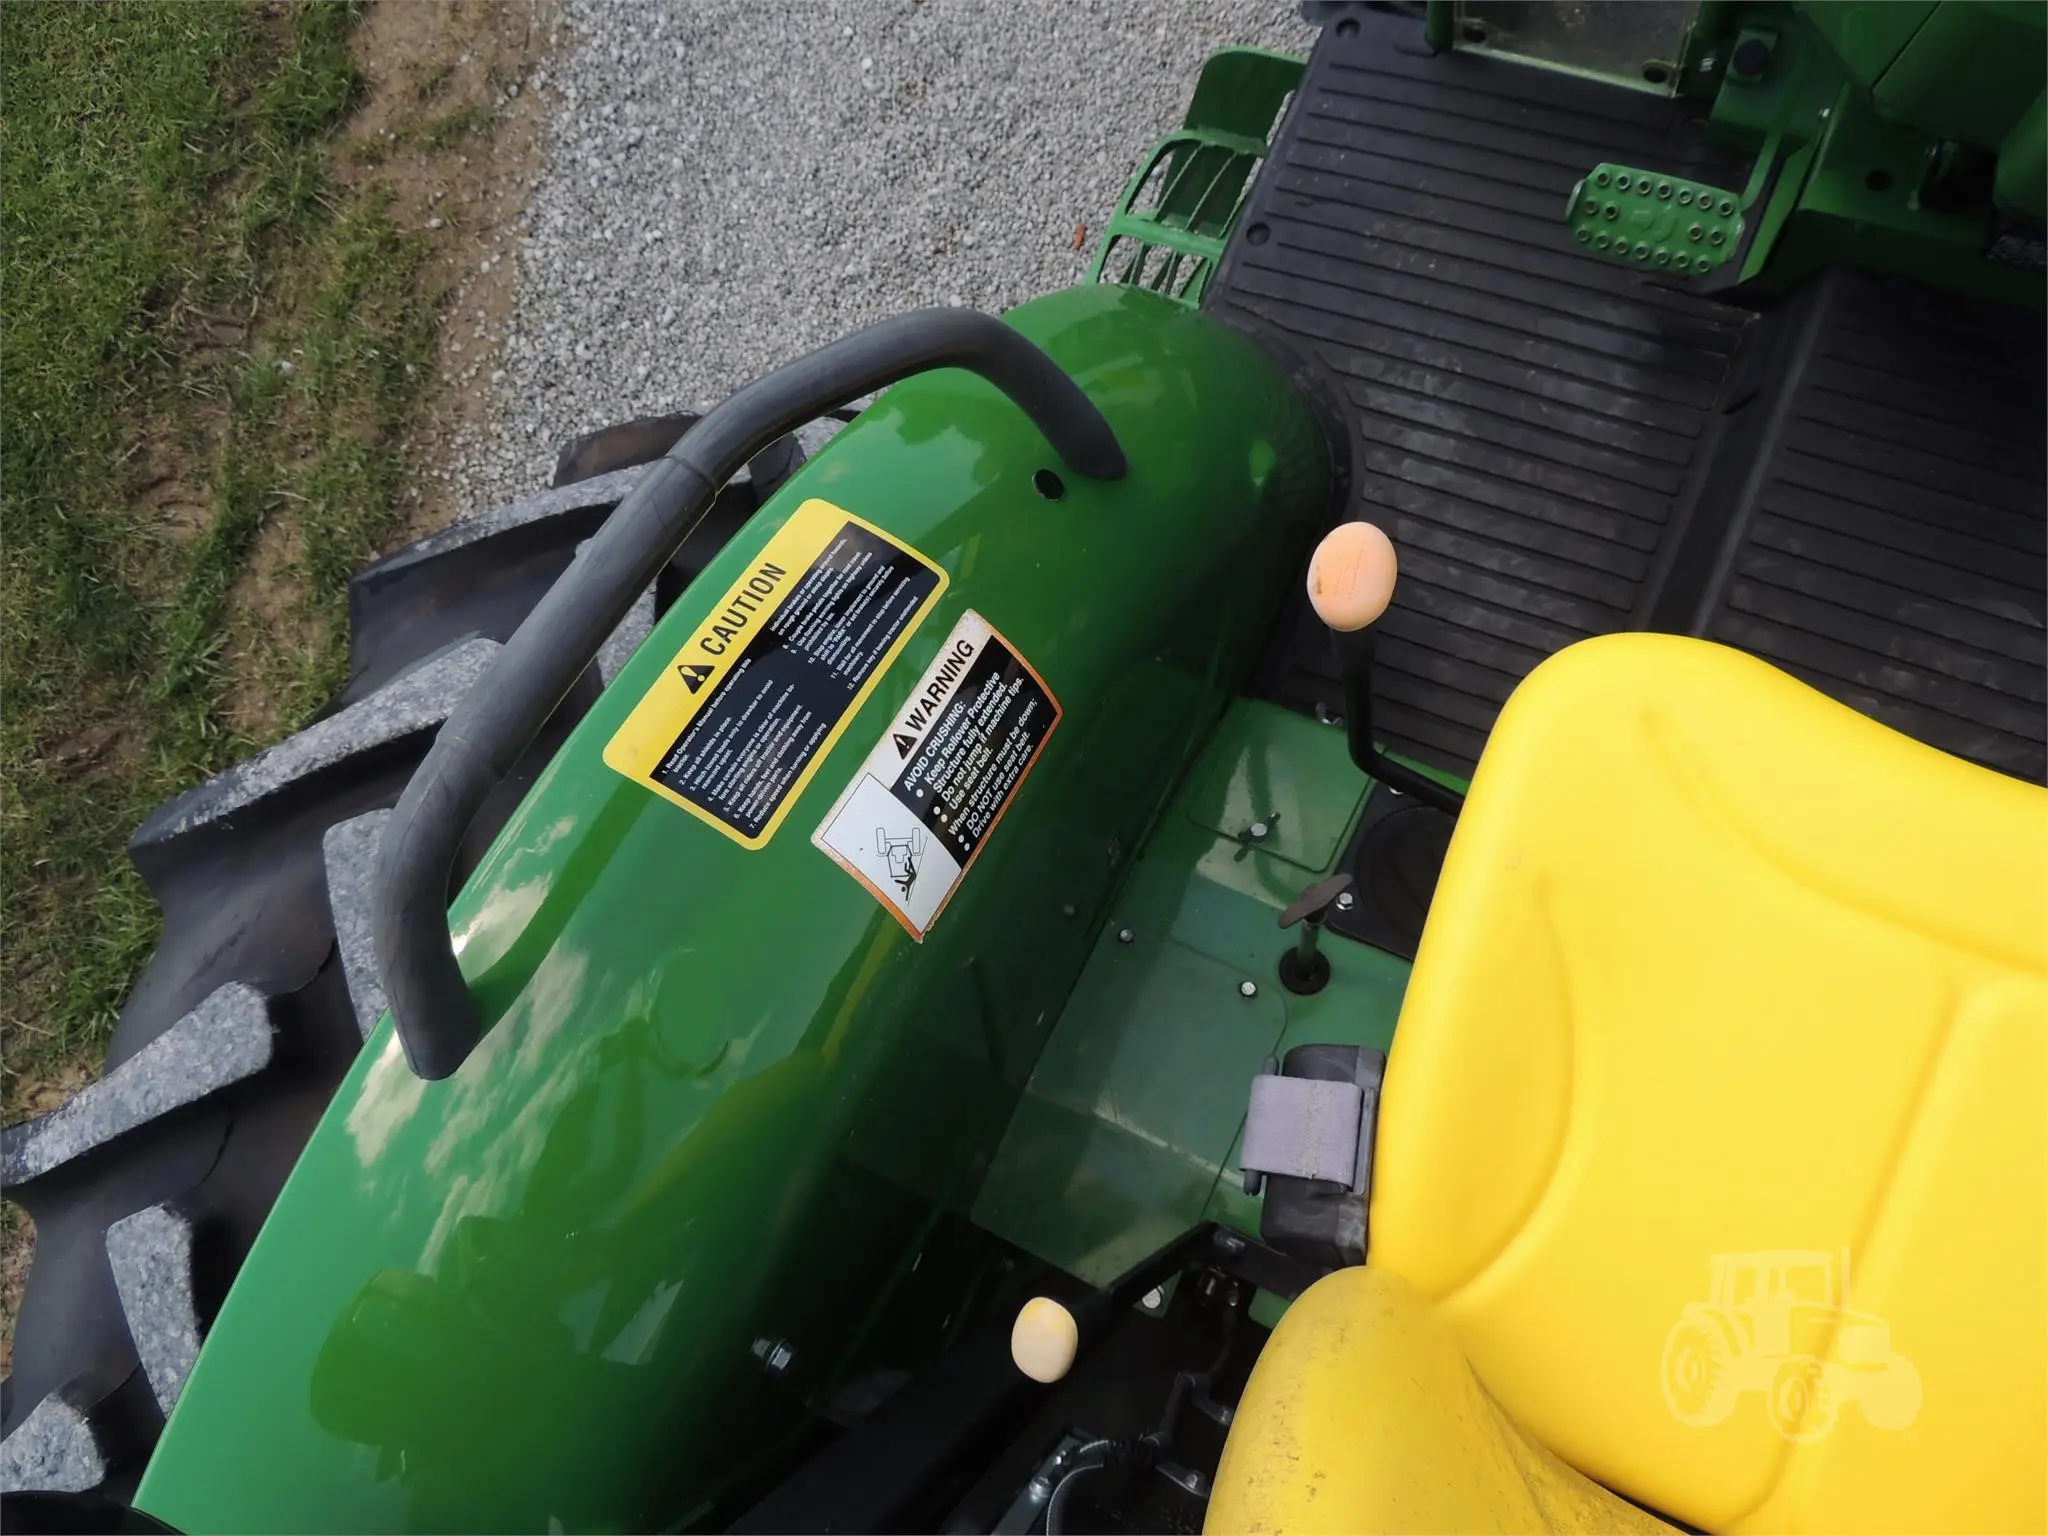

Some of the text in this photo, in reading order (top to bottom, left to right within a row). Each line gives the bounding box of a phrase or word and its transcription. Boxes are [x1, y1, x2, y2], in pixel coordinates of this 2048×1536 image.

[699, 562, 787, 656] CAUTION
[904, 639, 975, 732] WARNING
[923, 671, 1000, 788] Keep Rollover Protective
[903, 700, 967, 792] AVOID CRUSHING:
[932, 681, 1008, 794] Structure fully extended.
[940, 677, 1025, 803] Do not jump if machine tips.
[947, 697, 1038, 836] When structure must be down;
[948, 747, 994, 810] Use seat belt.
[965, 731, 1031, 831] DO NOT use seat belt.
[971, 744, 1034, 839] Drive with extra care.
